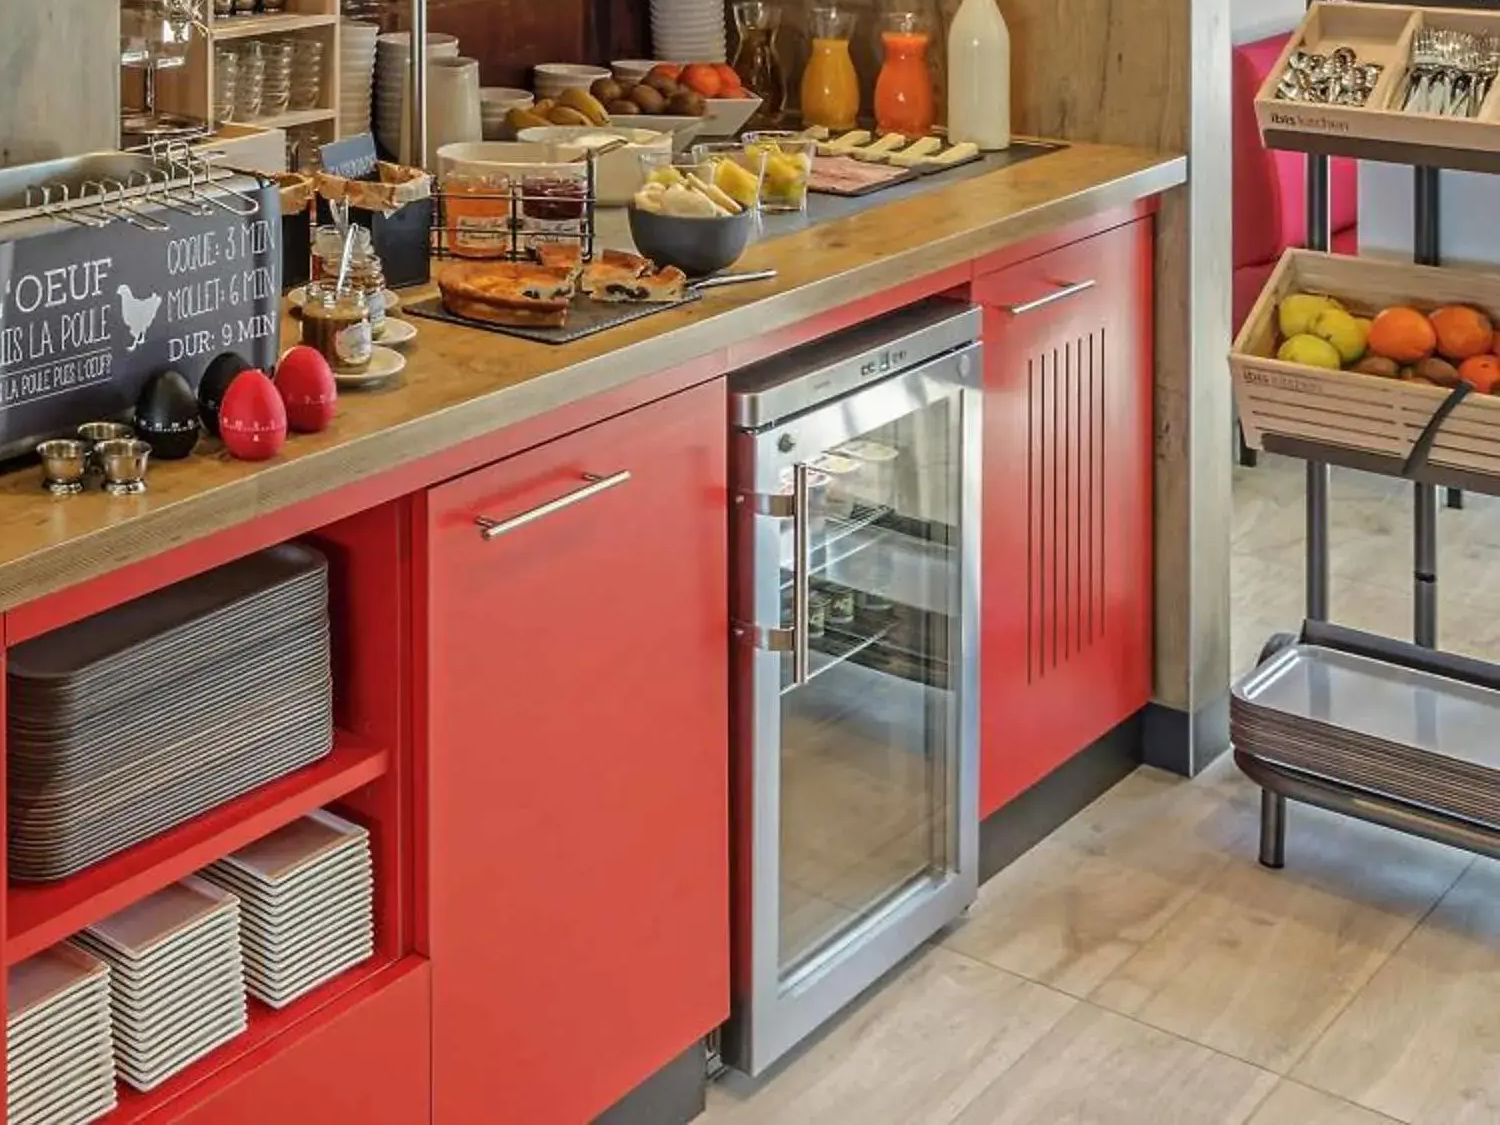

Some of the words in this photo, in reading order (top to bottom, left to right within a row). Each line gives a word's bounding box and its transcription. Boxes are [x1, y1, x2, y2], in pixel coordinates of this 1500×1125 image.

[225, 226, 236, 261] 3
[241, 219, 276, 259] MIN
[167, 278, 226, 323] MOLLET:
[229, 274, 240, 306] 6
[243, 264, 276, 303] MIN
[29, 320, 55, 359] LA
[61, 304, 111, 351] POULE
[168, 331, 216, 363] DUR:
[221, 322, 233, 347] 9
[238, 311, 277, 344] MIN
[5, 379, 19, 400] LA
[21, 368, 51, 395] POULE
